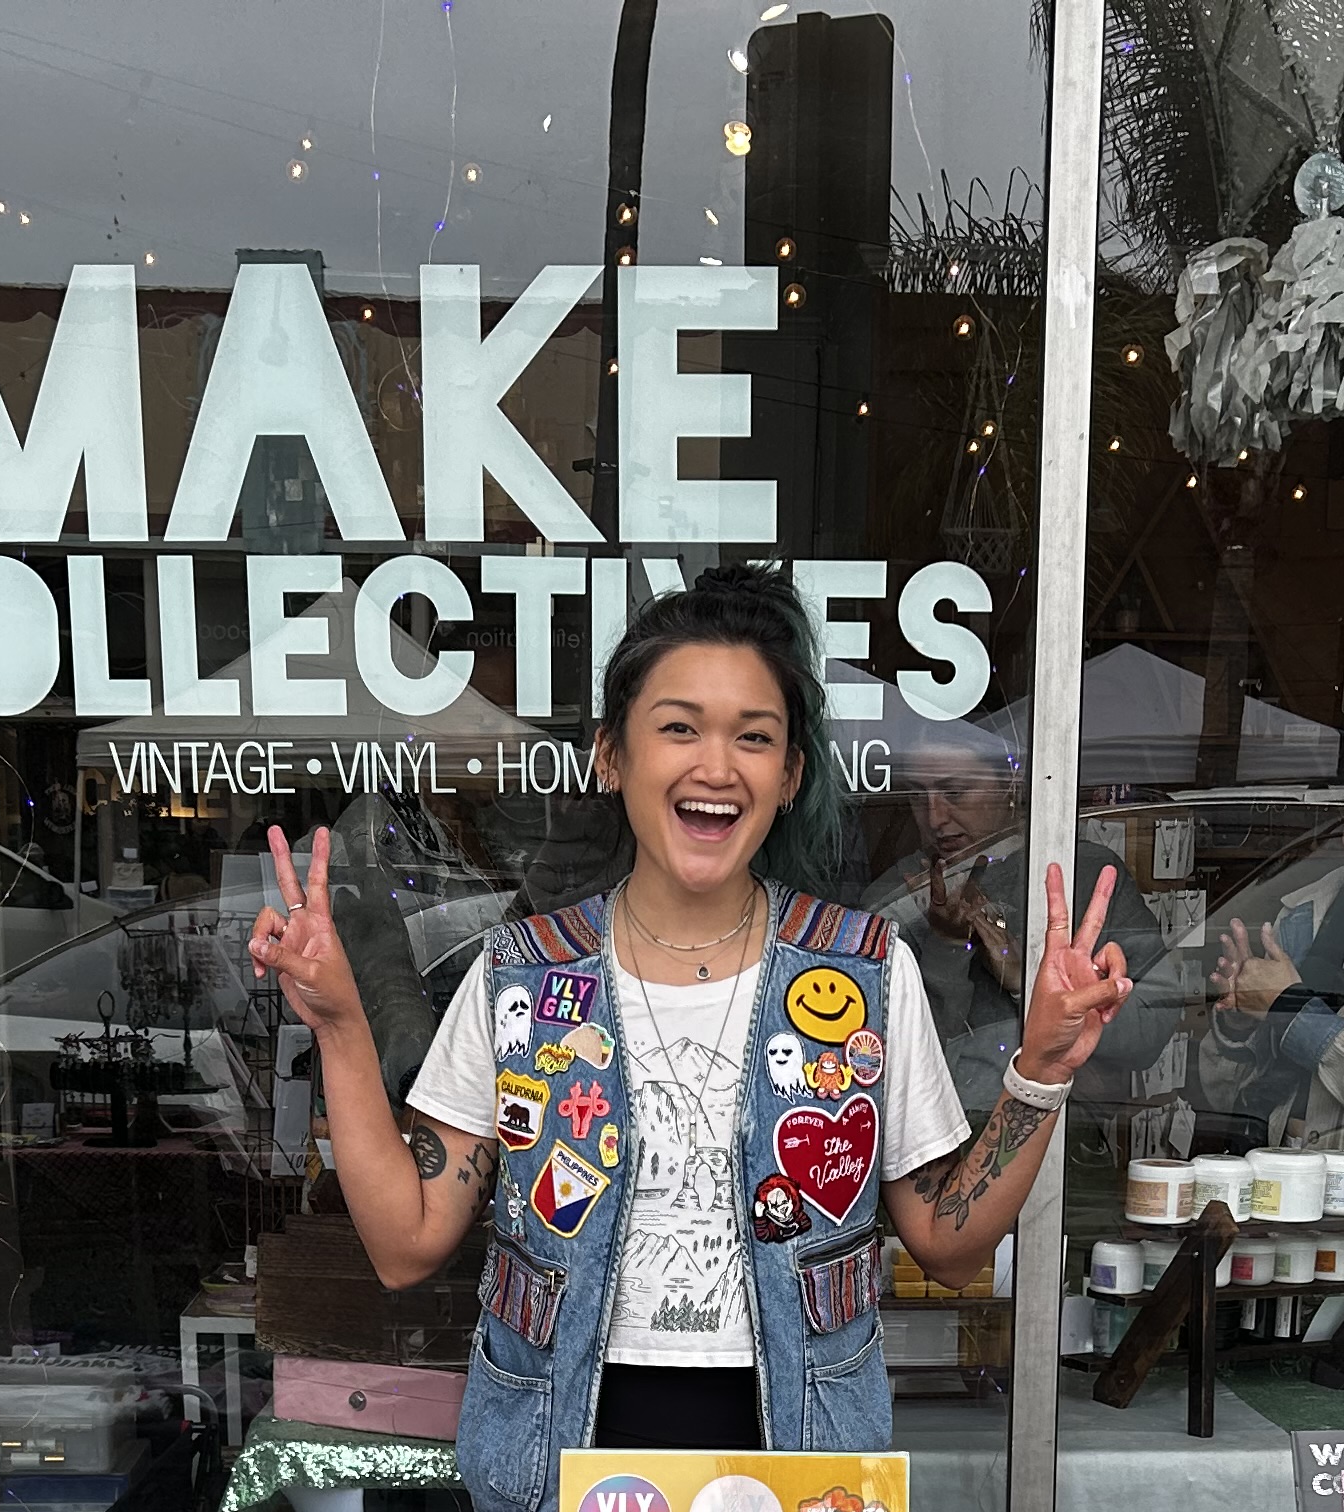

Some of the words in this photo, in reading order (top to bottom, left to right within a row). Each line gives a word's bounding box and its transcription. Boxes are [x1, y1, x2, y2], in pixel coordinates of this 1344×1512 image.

[109, 740, 296, 795] VINTAGE
[322, 740, 457, 795] VINYL
[551, 976, 593, 1001] VLY
[544, 1000, 583, 1022] GRL
[501, 1081, 544, 1103] CALIFORNIA
[786, 1116, 824, 1129] FOREVER
[824, 1137, 852, 1156] The
[557, 1151, 600, 1186] PHILIPPINES
[810, 1155, 864, 1189] Valley
